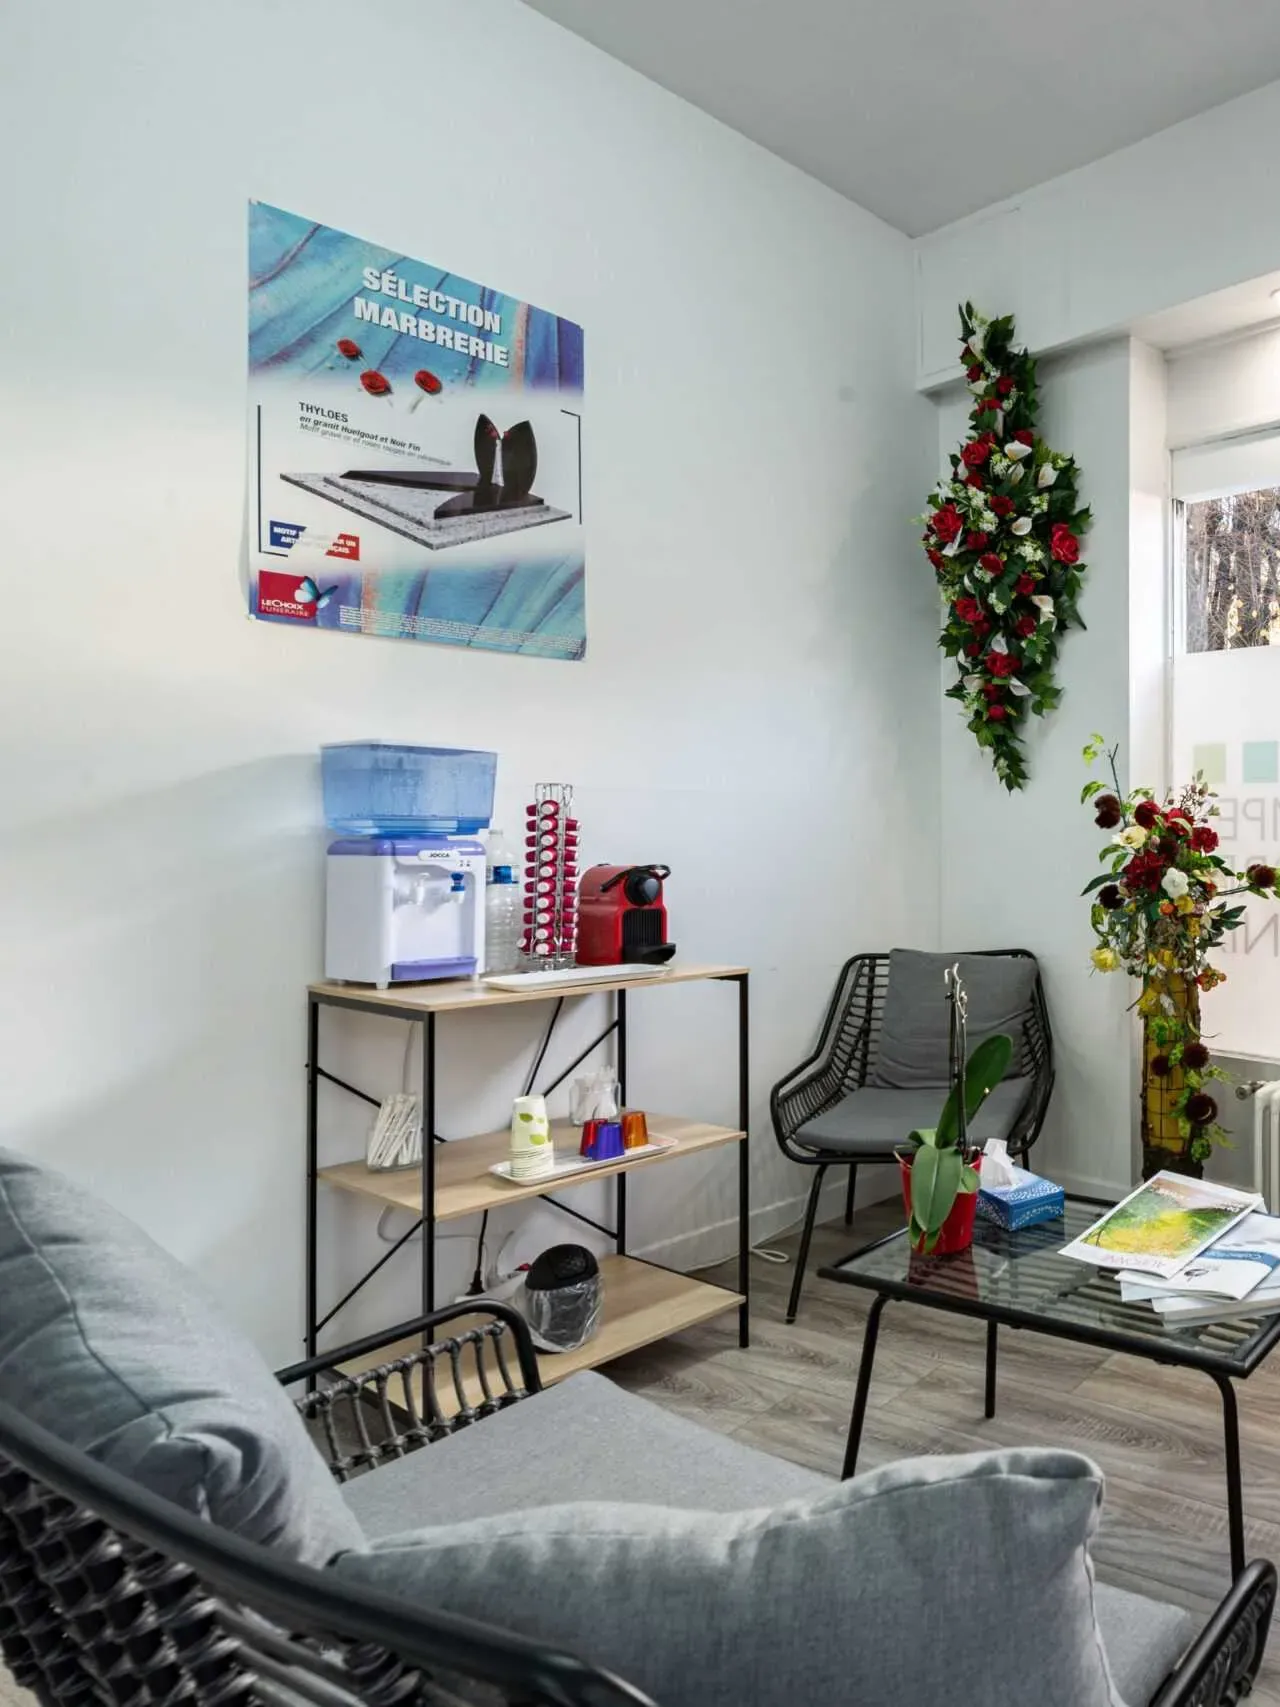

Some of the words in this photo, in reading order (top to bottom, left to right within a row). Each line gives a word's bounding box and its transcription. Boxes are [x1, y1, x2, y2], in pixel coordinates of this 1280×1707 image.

[362, 266, 502, 334] SÉLECTION
[354, 297, 509, 367] MARBRERIE
[299, 401, 349, 423] THYLOES
[299, 415, 312, 424] en
[313, 418, 340, 432] granit
[379, 436, 389, 444] et
[390, 438, 407, 448] Noir
[408, 442, 421, 452] Fin
